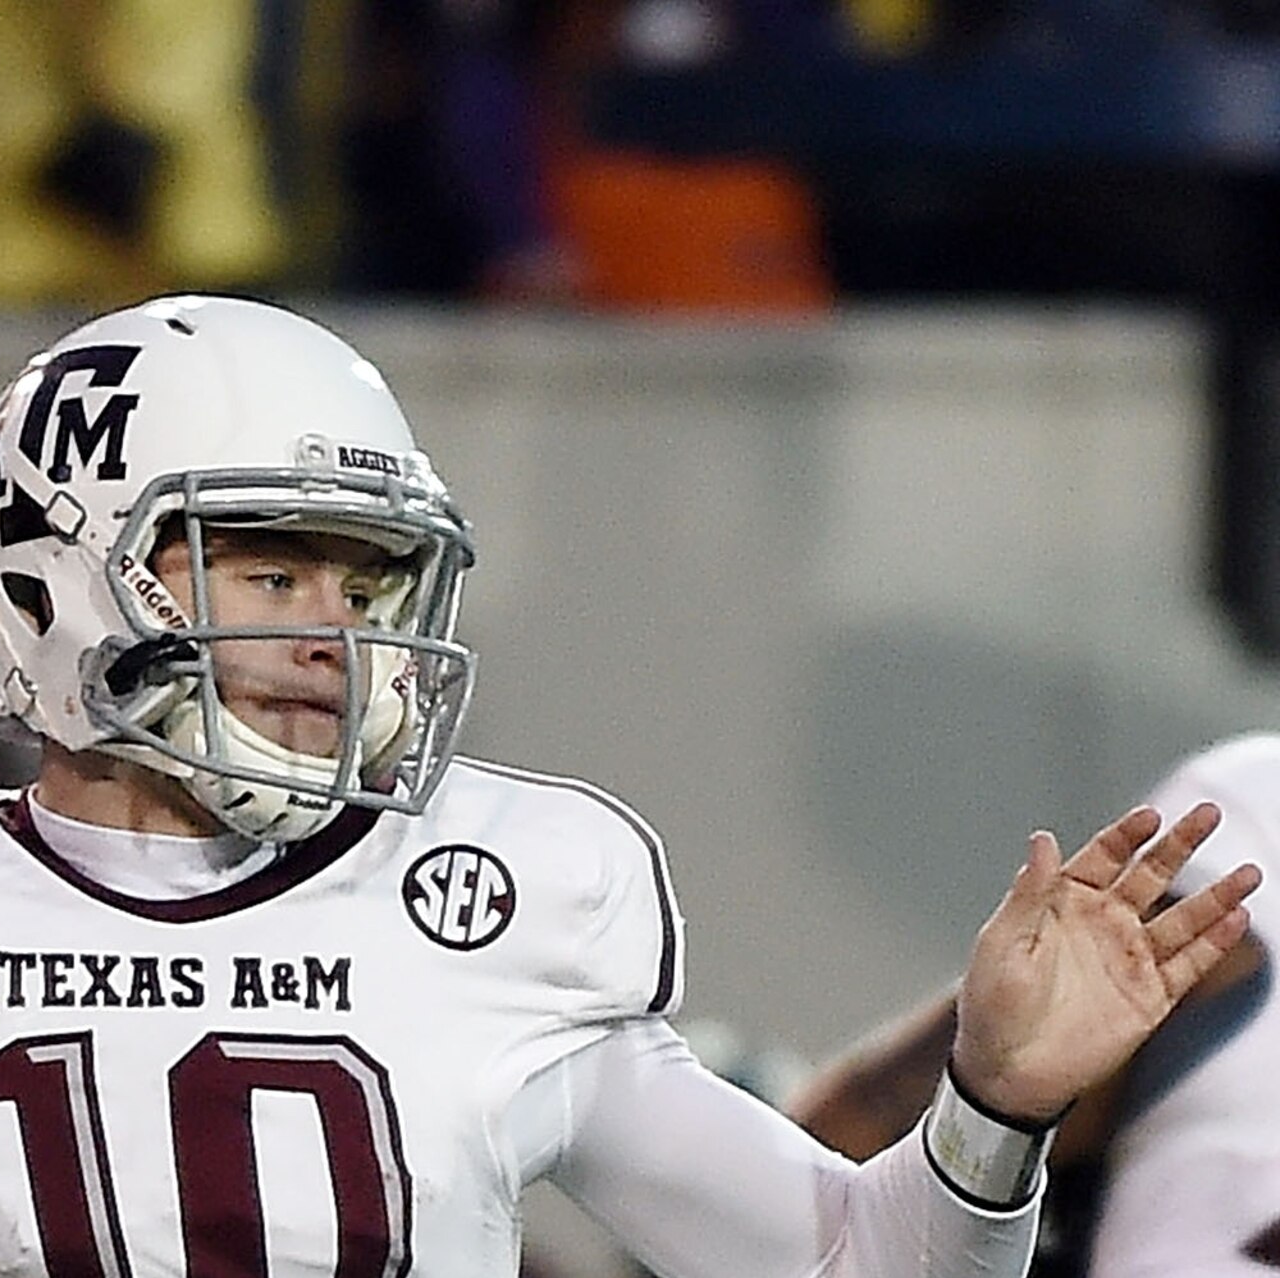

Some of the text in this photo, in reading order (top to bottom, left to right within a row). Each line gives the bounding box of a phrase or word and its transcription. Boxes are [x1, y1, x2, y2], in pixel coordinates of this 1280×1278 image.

[337, 446, 401, 477] AGGIES
[410, 850, 509, 943] SEC
[232, 957, 352, 1011] A&M
